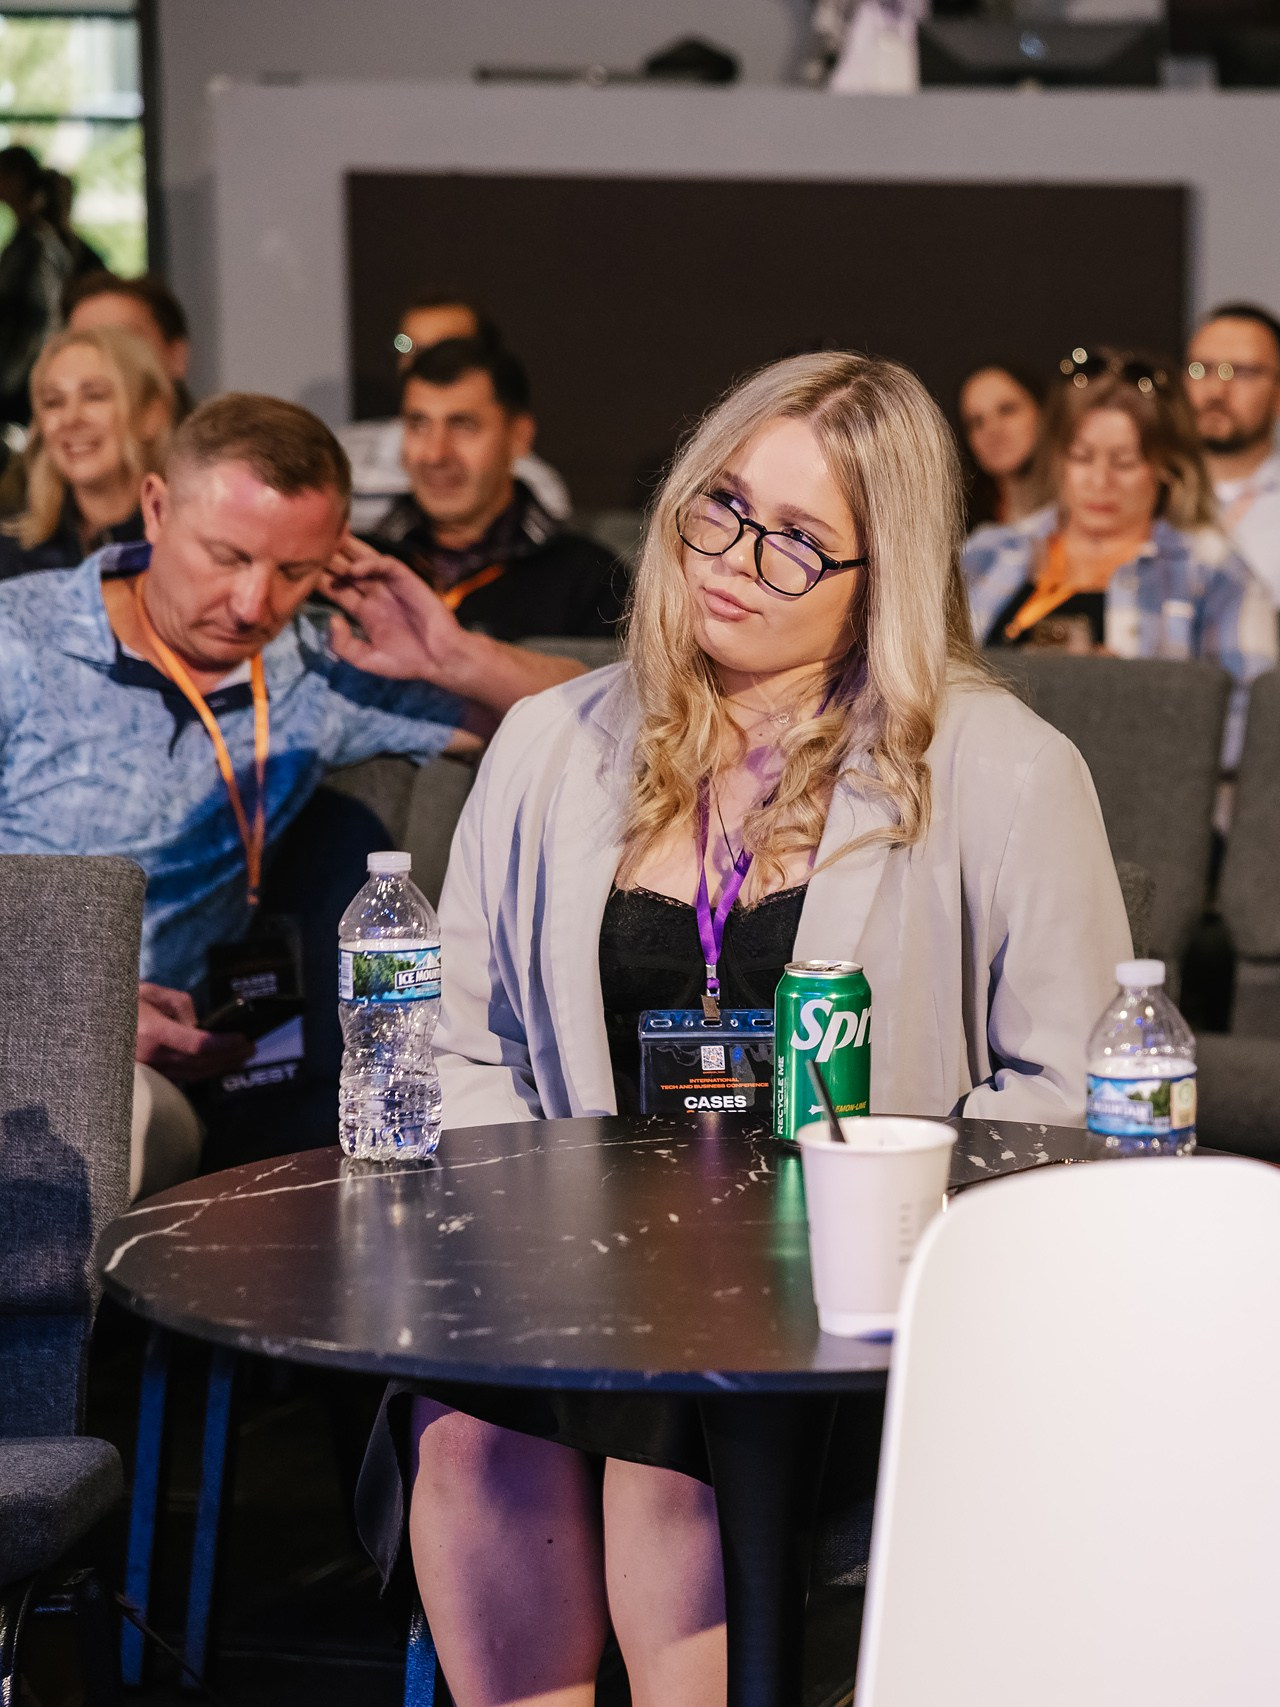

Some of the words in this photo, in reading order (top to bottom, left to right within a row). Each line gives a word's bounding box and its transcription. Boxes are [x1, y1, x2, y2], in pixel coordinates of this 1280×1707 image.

[398, 972, 415, 986] ICE
[777, 1055, 785, 1075] ME
[223, 1062, 298, 1092] GUEST
[684, 1095, 747, 1109] CASES
